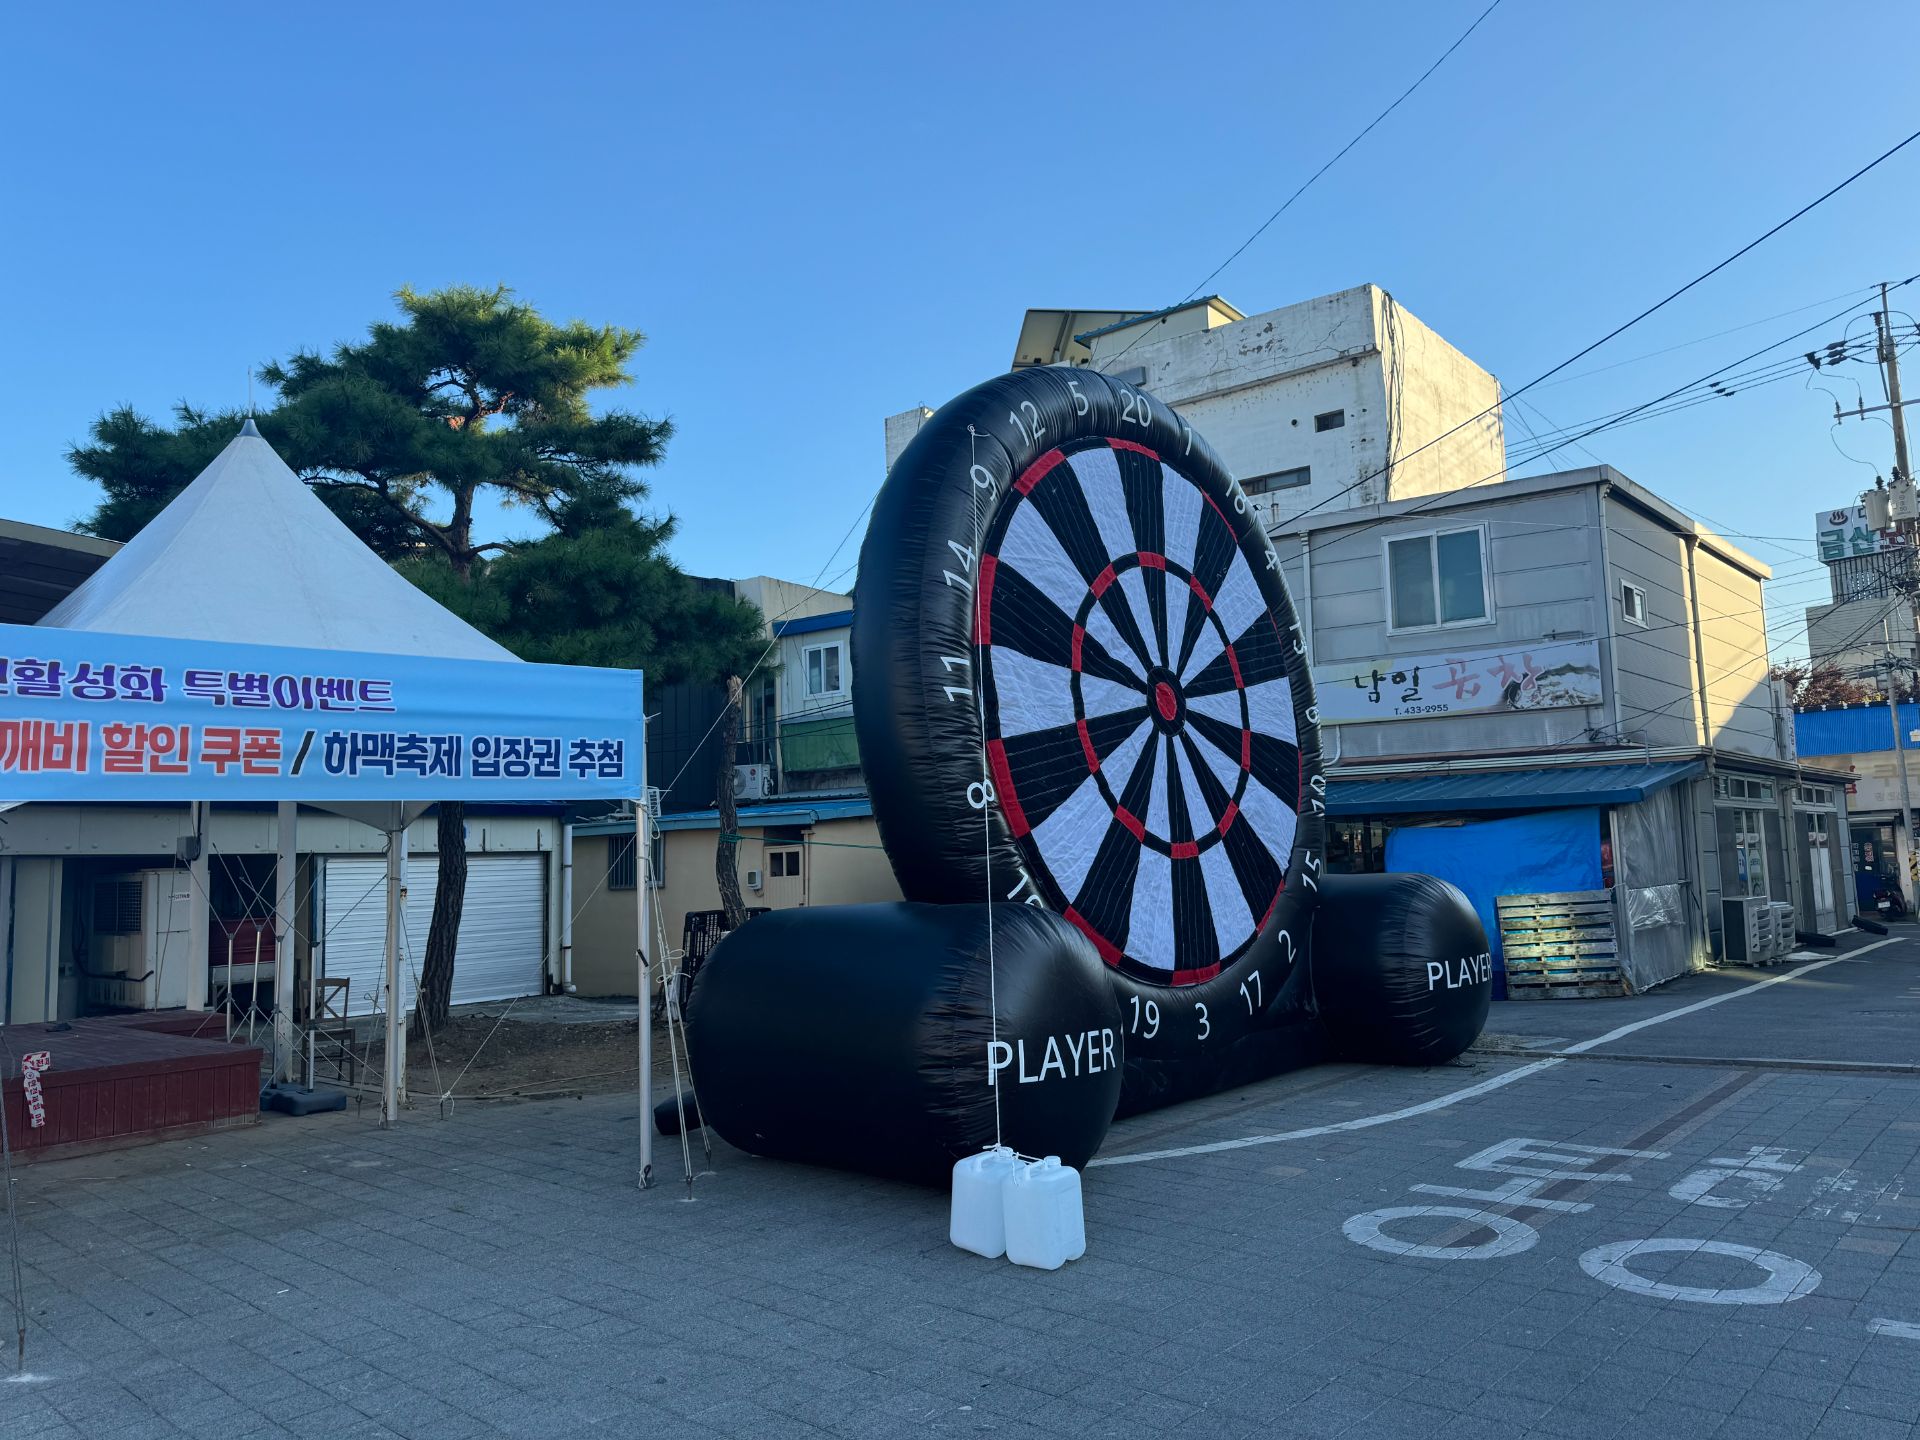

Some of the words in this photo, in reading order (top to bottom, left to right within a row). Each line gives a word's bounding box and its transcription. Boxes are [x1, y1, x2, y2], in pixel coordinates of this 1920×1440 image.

[1068, 380, 1088, 416] 5
[1121, 388, 1152, 427] 20
[1009, 400, 1045, 447] 12
[970, 463, 997, 502] 9
[1264, 550, 1278, 571] 4
[1820, 525, 1874, 559] 금산
[944, 539, 976, 590] 14
[0, 658, 168, 702] 활성화
[183, 670, 396, 712] 특별이벤트
[942, 655, 972, 702] 11
[1354, 666, 1423, 704] 남일
[1403, 703, 1449, 715] 433-2955
[102, 723, 190, 774] 할인
[201, 727, 281, 775] 쿠폰
[324, 731, 462, 777] 하맥축제
[471, 737, 561, 777] 입장권
[568, 739, 624, 778] 추첨
[967, 779, 995, 809] 8
[1301, 850, 1321, 893] 15
[1276, 929, 1296, 964] 2
[1426, 952, 1493, 992] PLAYER
[1239, 969, 1264, 1016] 17
[1130, 994, 1160, 1039] 19
[1195, 1002, 1211, 1041] 3
[986, 1028, 1116, 1086] PLAYER
